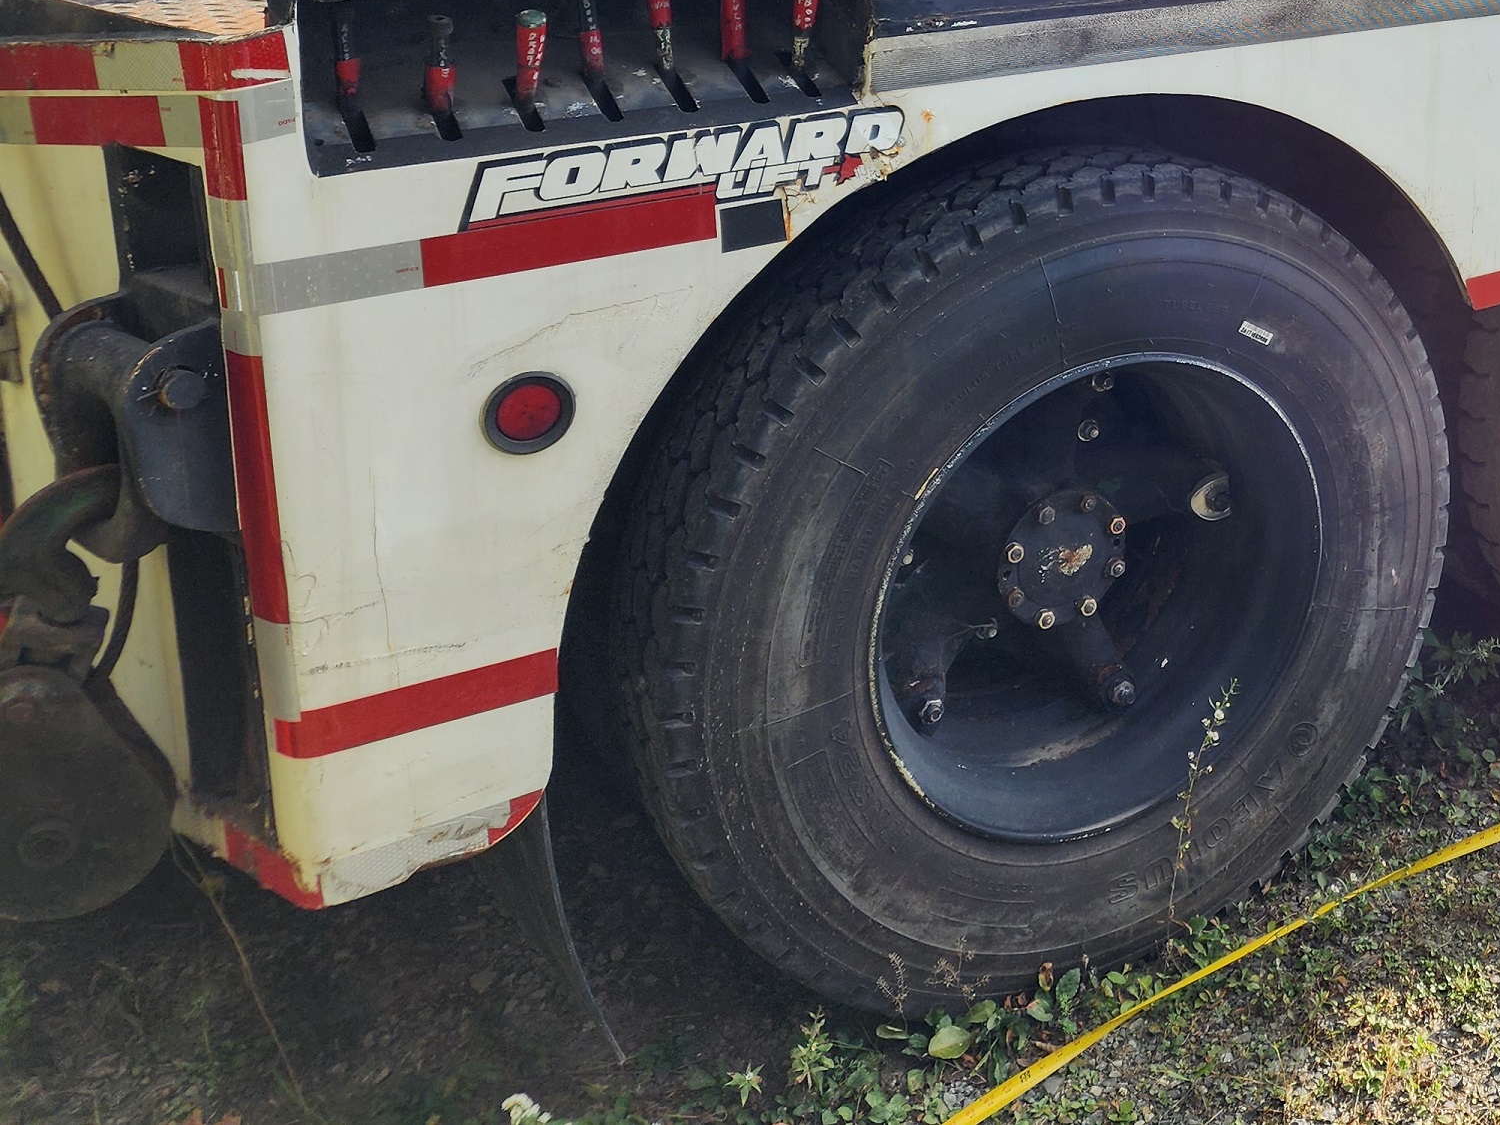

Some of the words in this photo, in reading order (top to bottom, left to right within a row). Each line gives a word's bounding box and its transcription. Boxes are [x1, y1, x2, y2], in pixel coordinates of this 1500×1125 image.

[467, 107, 906, 225] FORWARD
[715, 157, 835, 200] LIFT
[1106, 759, 1284, 905] AEOLUS
